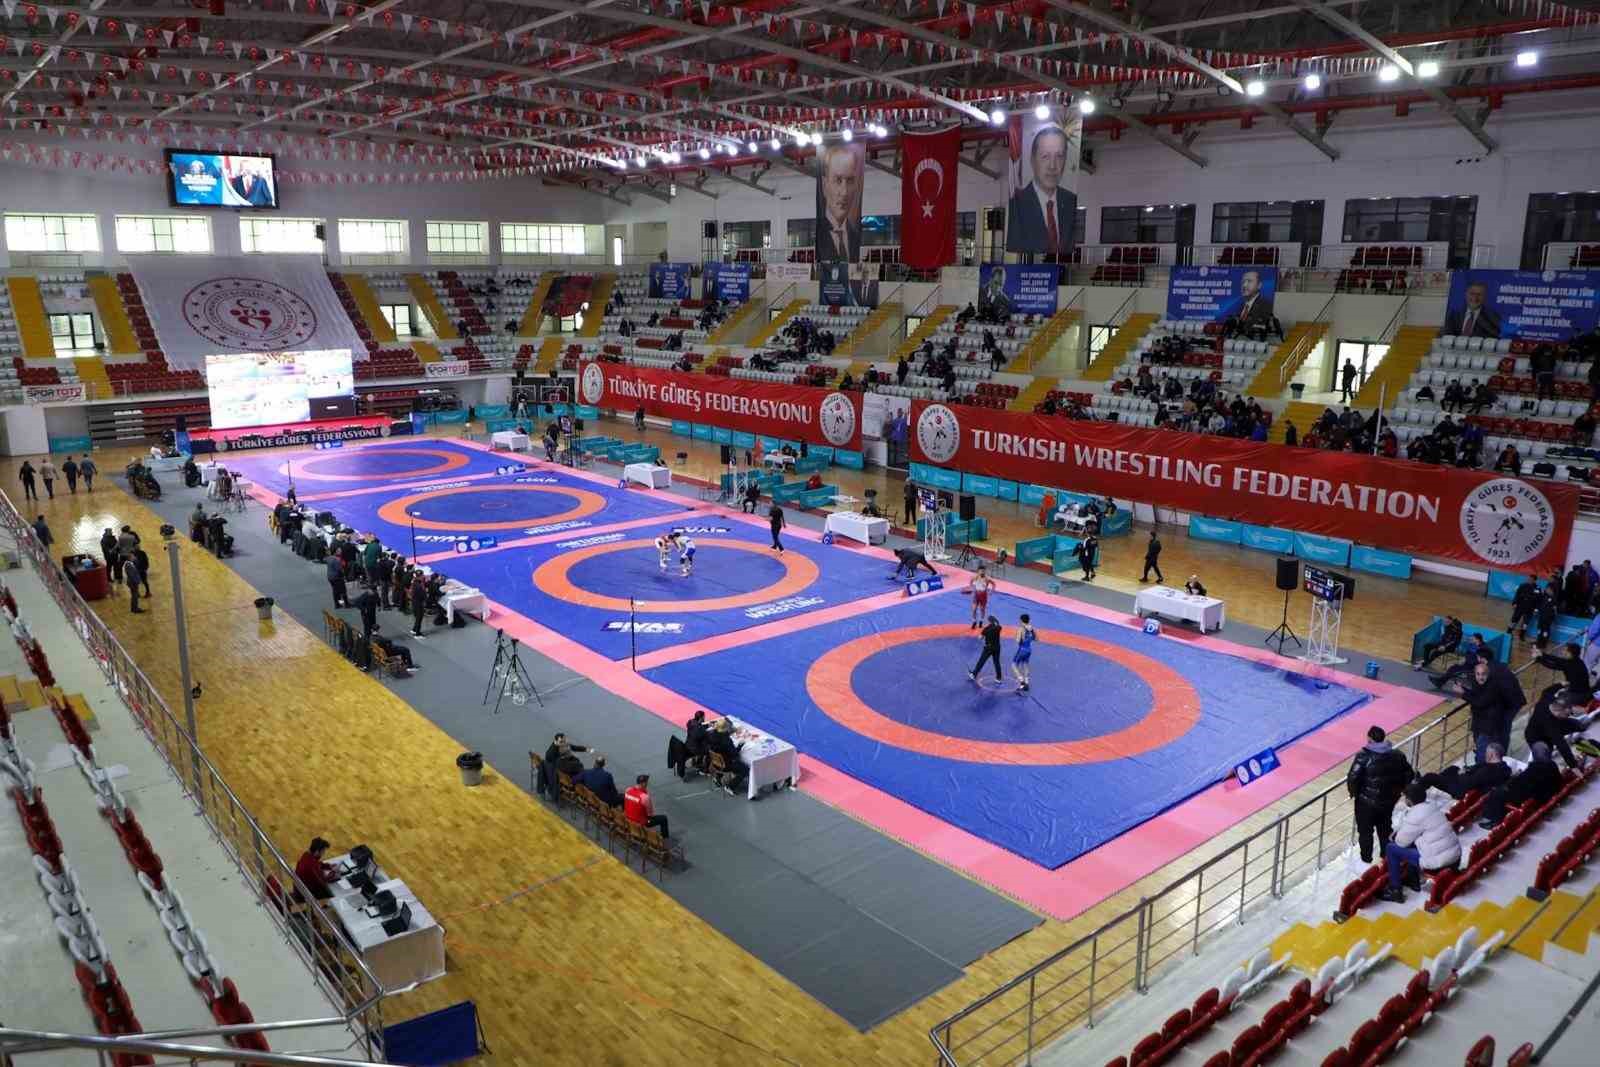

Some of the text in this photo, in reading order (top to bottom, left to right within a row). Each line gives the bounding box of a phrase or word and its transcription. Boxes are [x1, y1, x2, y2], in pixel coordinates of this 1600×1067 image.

[608, 375, 657, 401] TÜRKİYE
[661, 386, 702, 412] GÜREŞ
[705, 391, 813, 425] FEDERASYONU
[971, 428, 1066, 463] TURKISH
[1073, 443, 1223, 487] WRESTLING
[1232, 466, 1441, 523] FEDERATION
[1487, 548, 1510, 558] 1923
